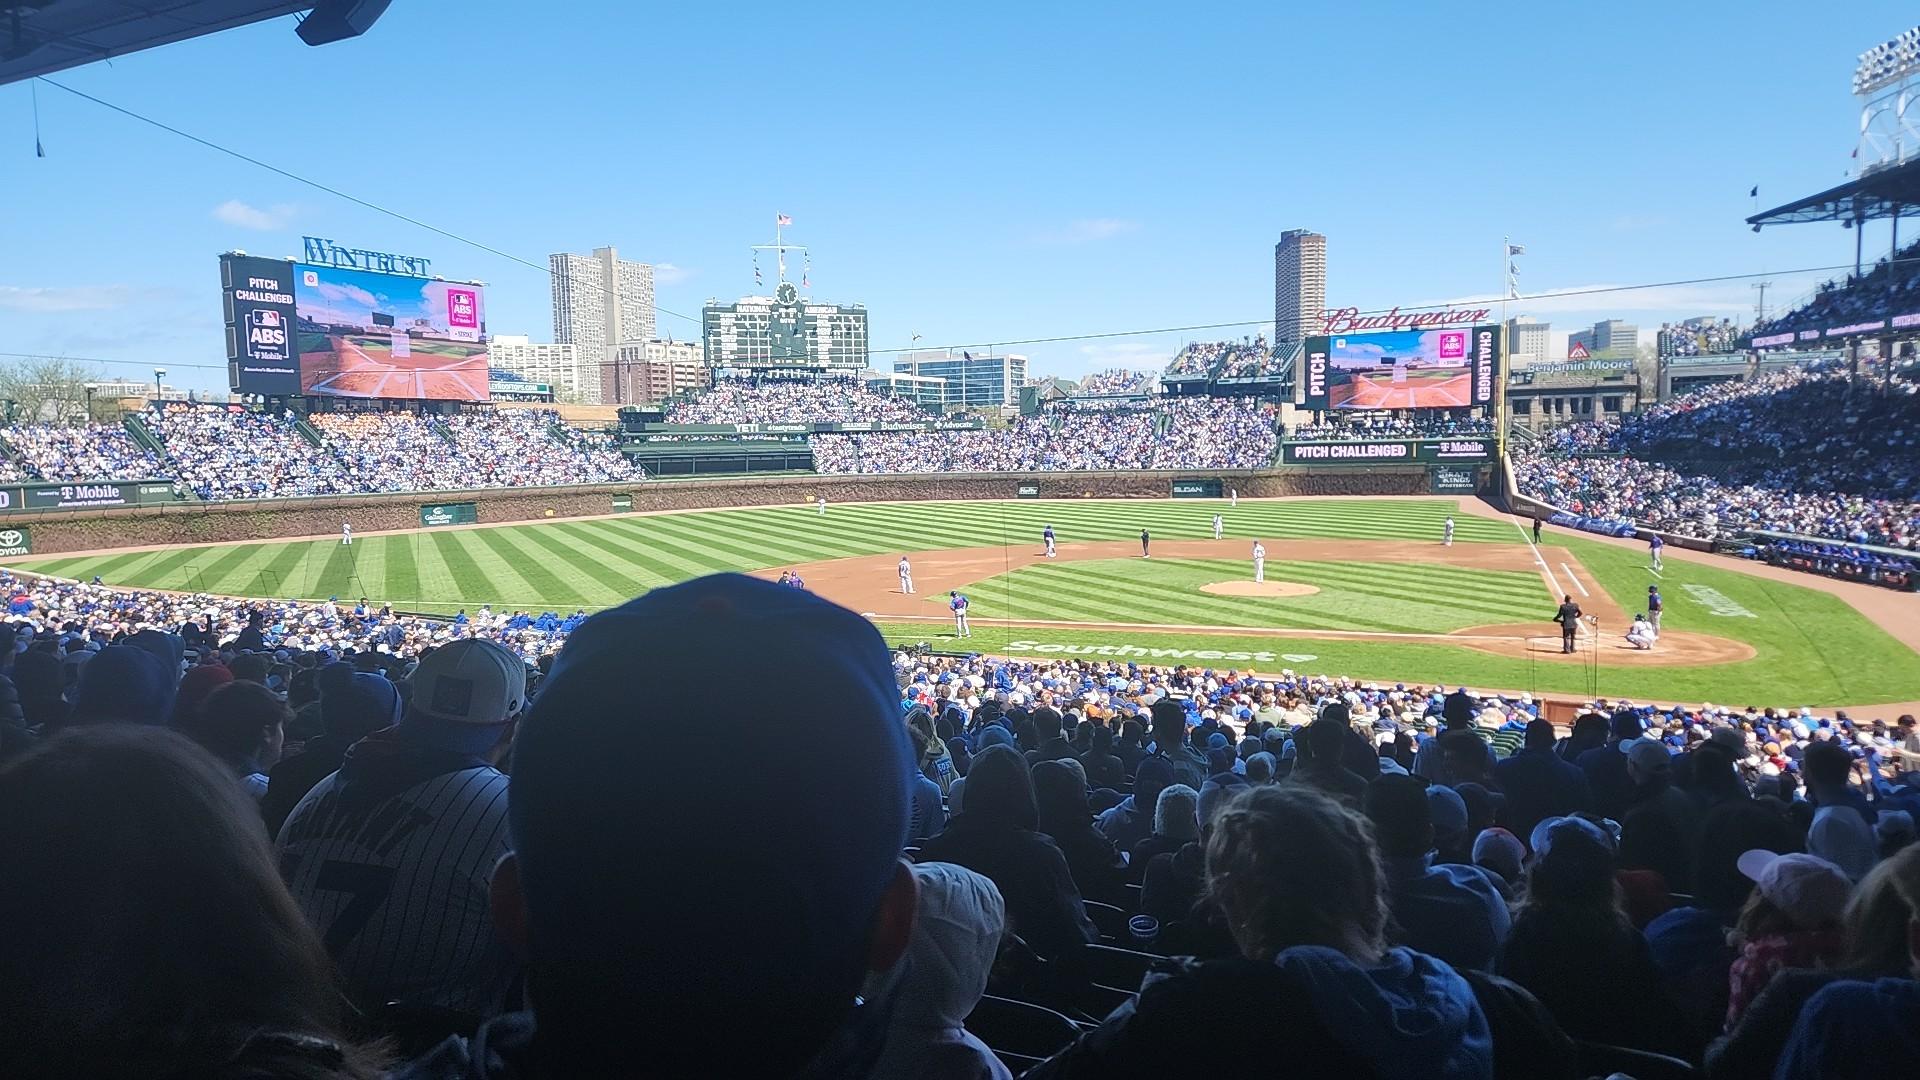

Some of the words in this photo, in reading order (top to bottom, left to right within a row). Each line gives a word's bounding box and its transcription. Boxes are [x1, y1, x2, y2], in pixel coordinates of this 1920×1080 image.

[302, 236, 431, 276] WINTRUST
[249, 277, 279, 290] PITCH
[235, 289, 294, 305] CHALLENGED
[454, 303, 472, 315] ABS
[737, 304, 771, 313] NATIONAL
[804, 306, 838, 314] AMERICAN
[1317, 307, 1490, 334] Budweiser
[251, 327, 285, 345] ABS
[1444, 342, 1460, 350] ABS
[261, 351, 283, 361] Mobile
[1477, 331, 1492, 401] CHALLENGED
[1527, 360, 1585, 374] Benjamin
[1589, 359, 1632, 370] Moore
[1311, 352, 1326, 396] PITCH
[734, 423, 760, 433] YETI
[881, 421, 927, 431] Budweiser
[943, 421, 974, 430] Advocate
[1295, 445, 1330, 459] PITCH
[1330, 444, 1407, 458] CHALLENGED
[1450, 441, 1485, 452] Mobile
[75, 484, 120, 499] Mobile
[1002, 640, 1279, 662] Southwest
